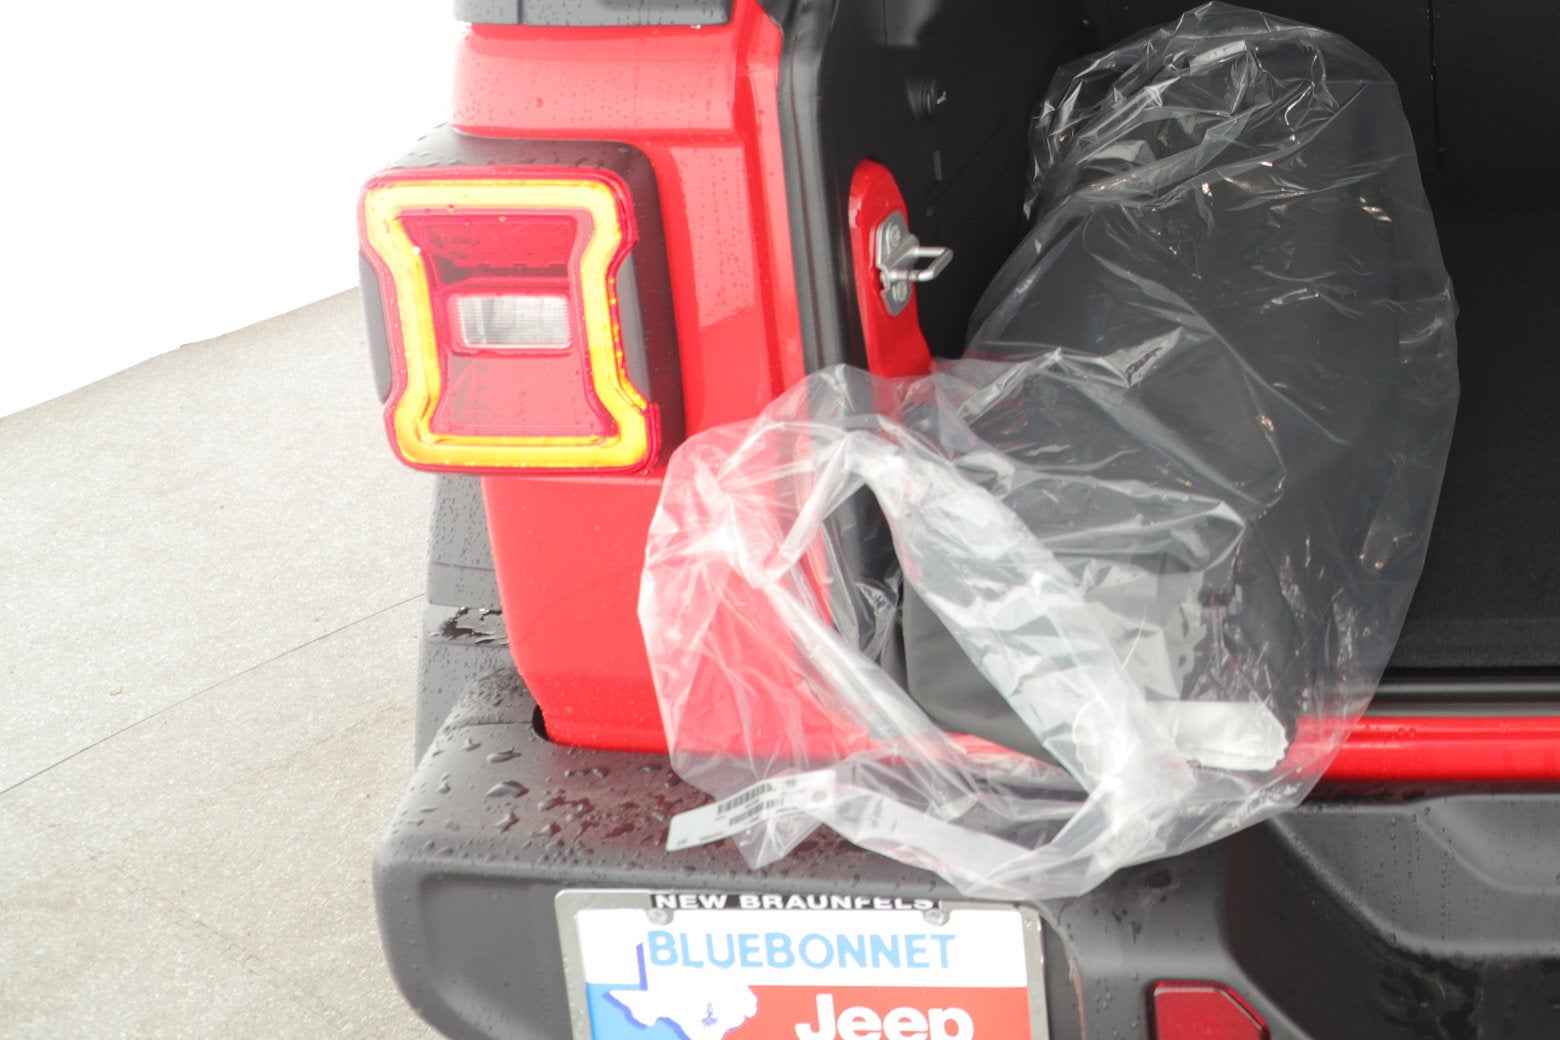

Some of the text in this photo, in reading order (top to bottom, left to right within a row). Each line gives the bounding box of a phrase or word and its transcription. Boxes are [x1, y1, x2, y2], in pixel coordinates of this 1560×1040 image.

[655, 894, 936, 910] NEW BRAUNFELS
[647, 930, 957, 969] BLUEBONNET
[794, 993, 975, 1040] Jeep
